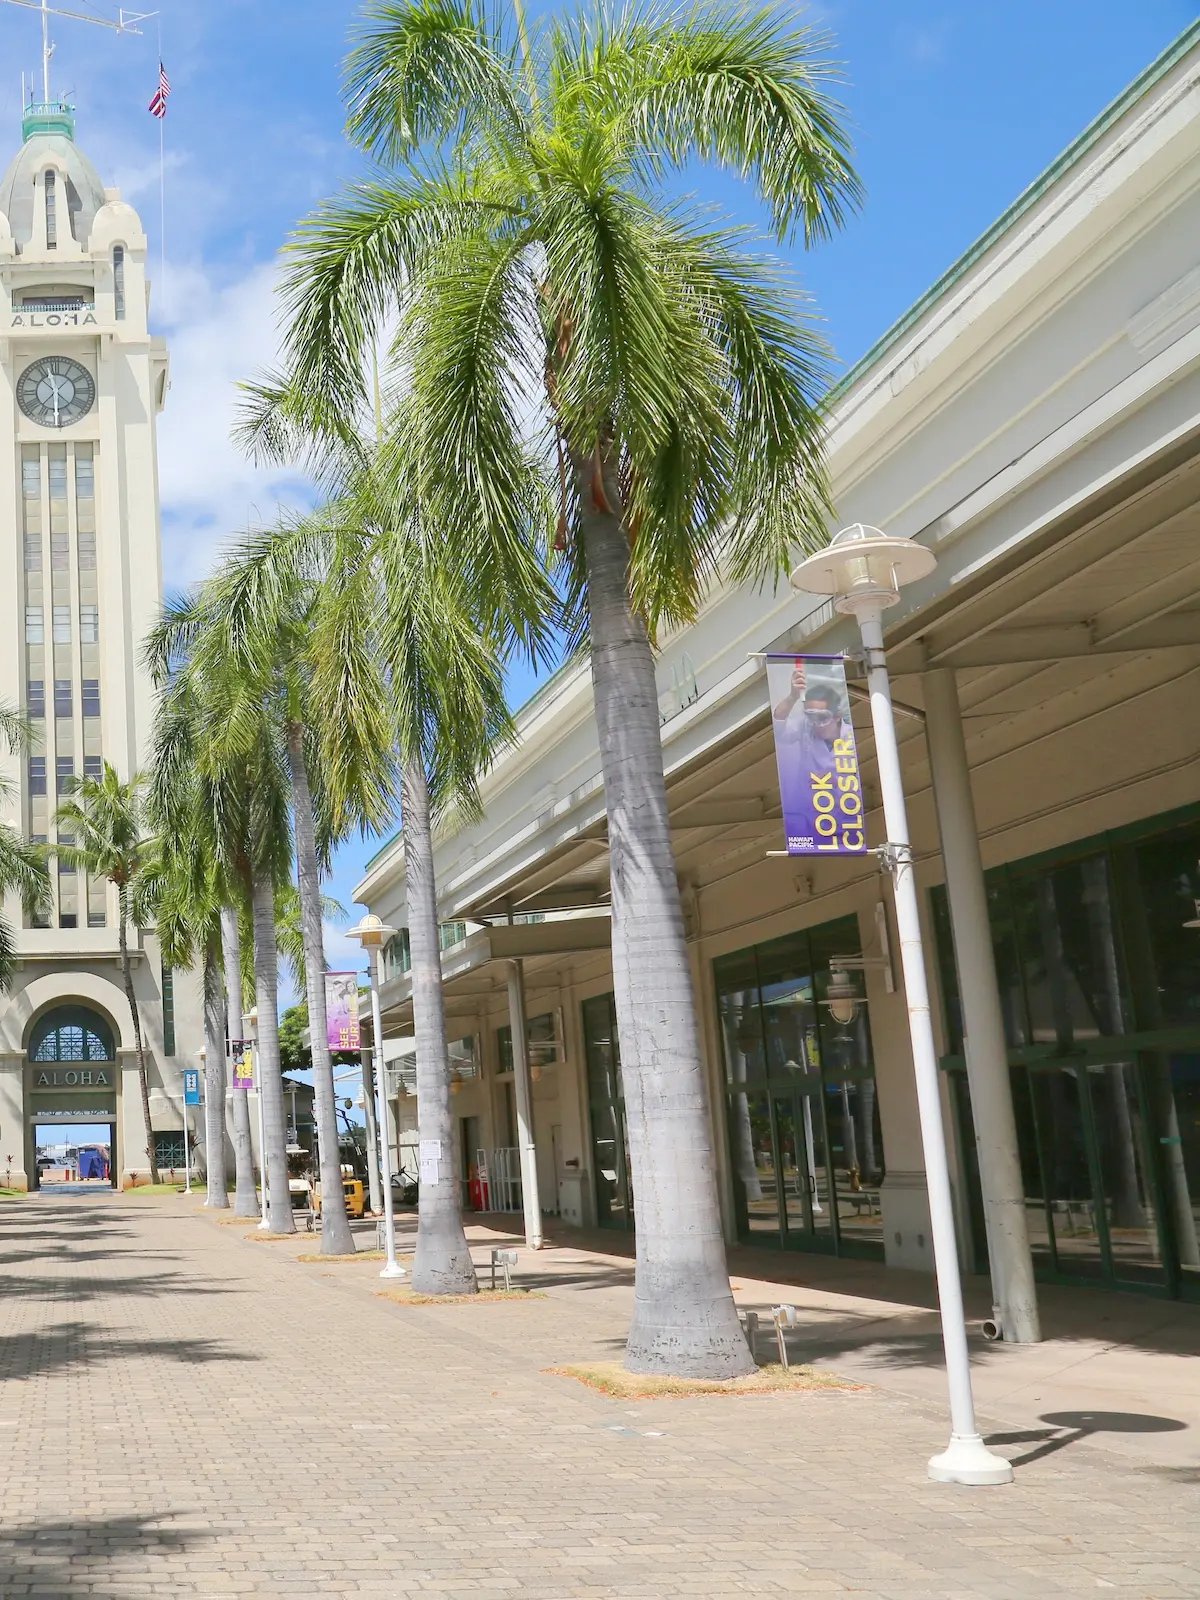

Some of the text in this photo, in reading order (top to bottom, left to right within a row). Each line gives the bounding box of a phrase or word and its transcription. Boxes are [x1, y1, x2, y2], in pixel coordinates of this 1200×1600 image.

[11, 313, 98, 327] ALOHA
[833, 732, 865, 851] CLOSER.
[810, 771, 840, 851] LOOK
[340, 1027, 349, 1049] SEE
[38, 1071, 108, 1086] ALOHA
